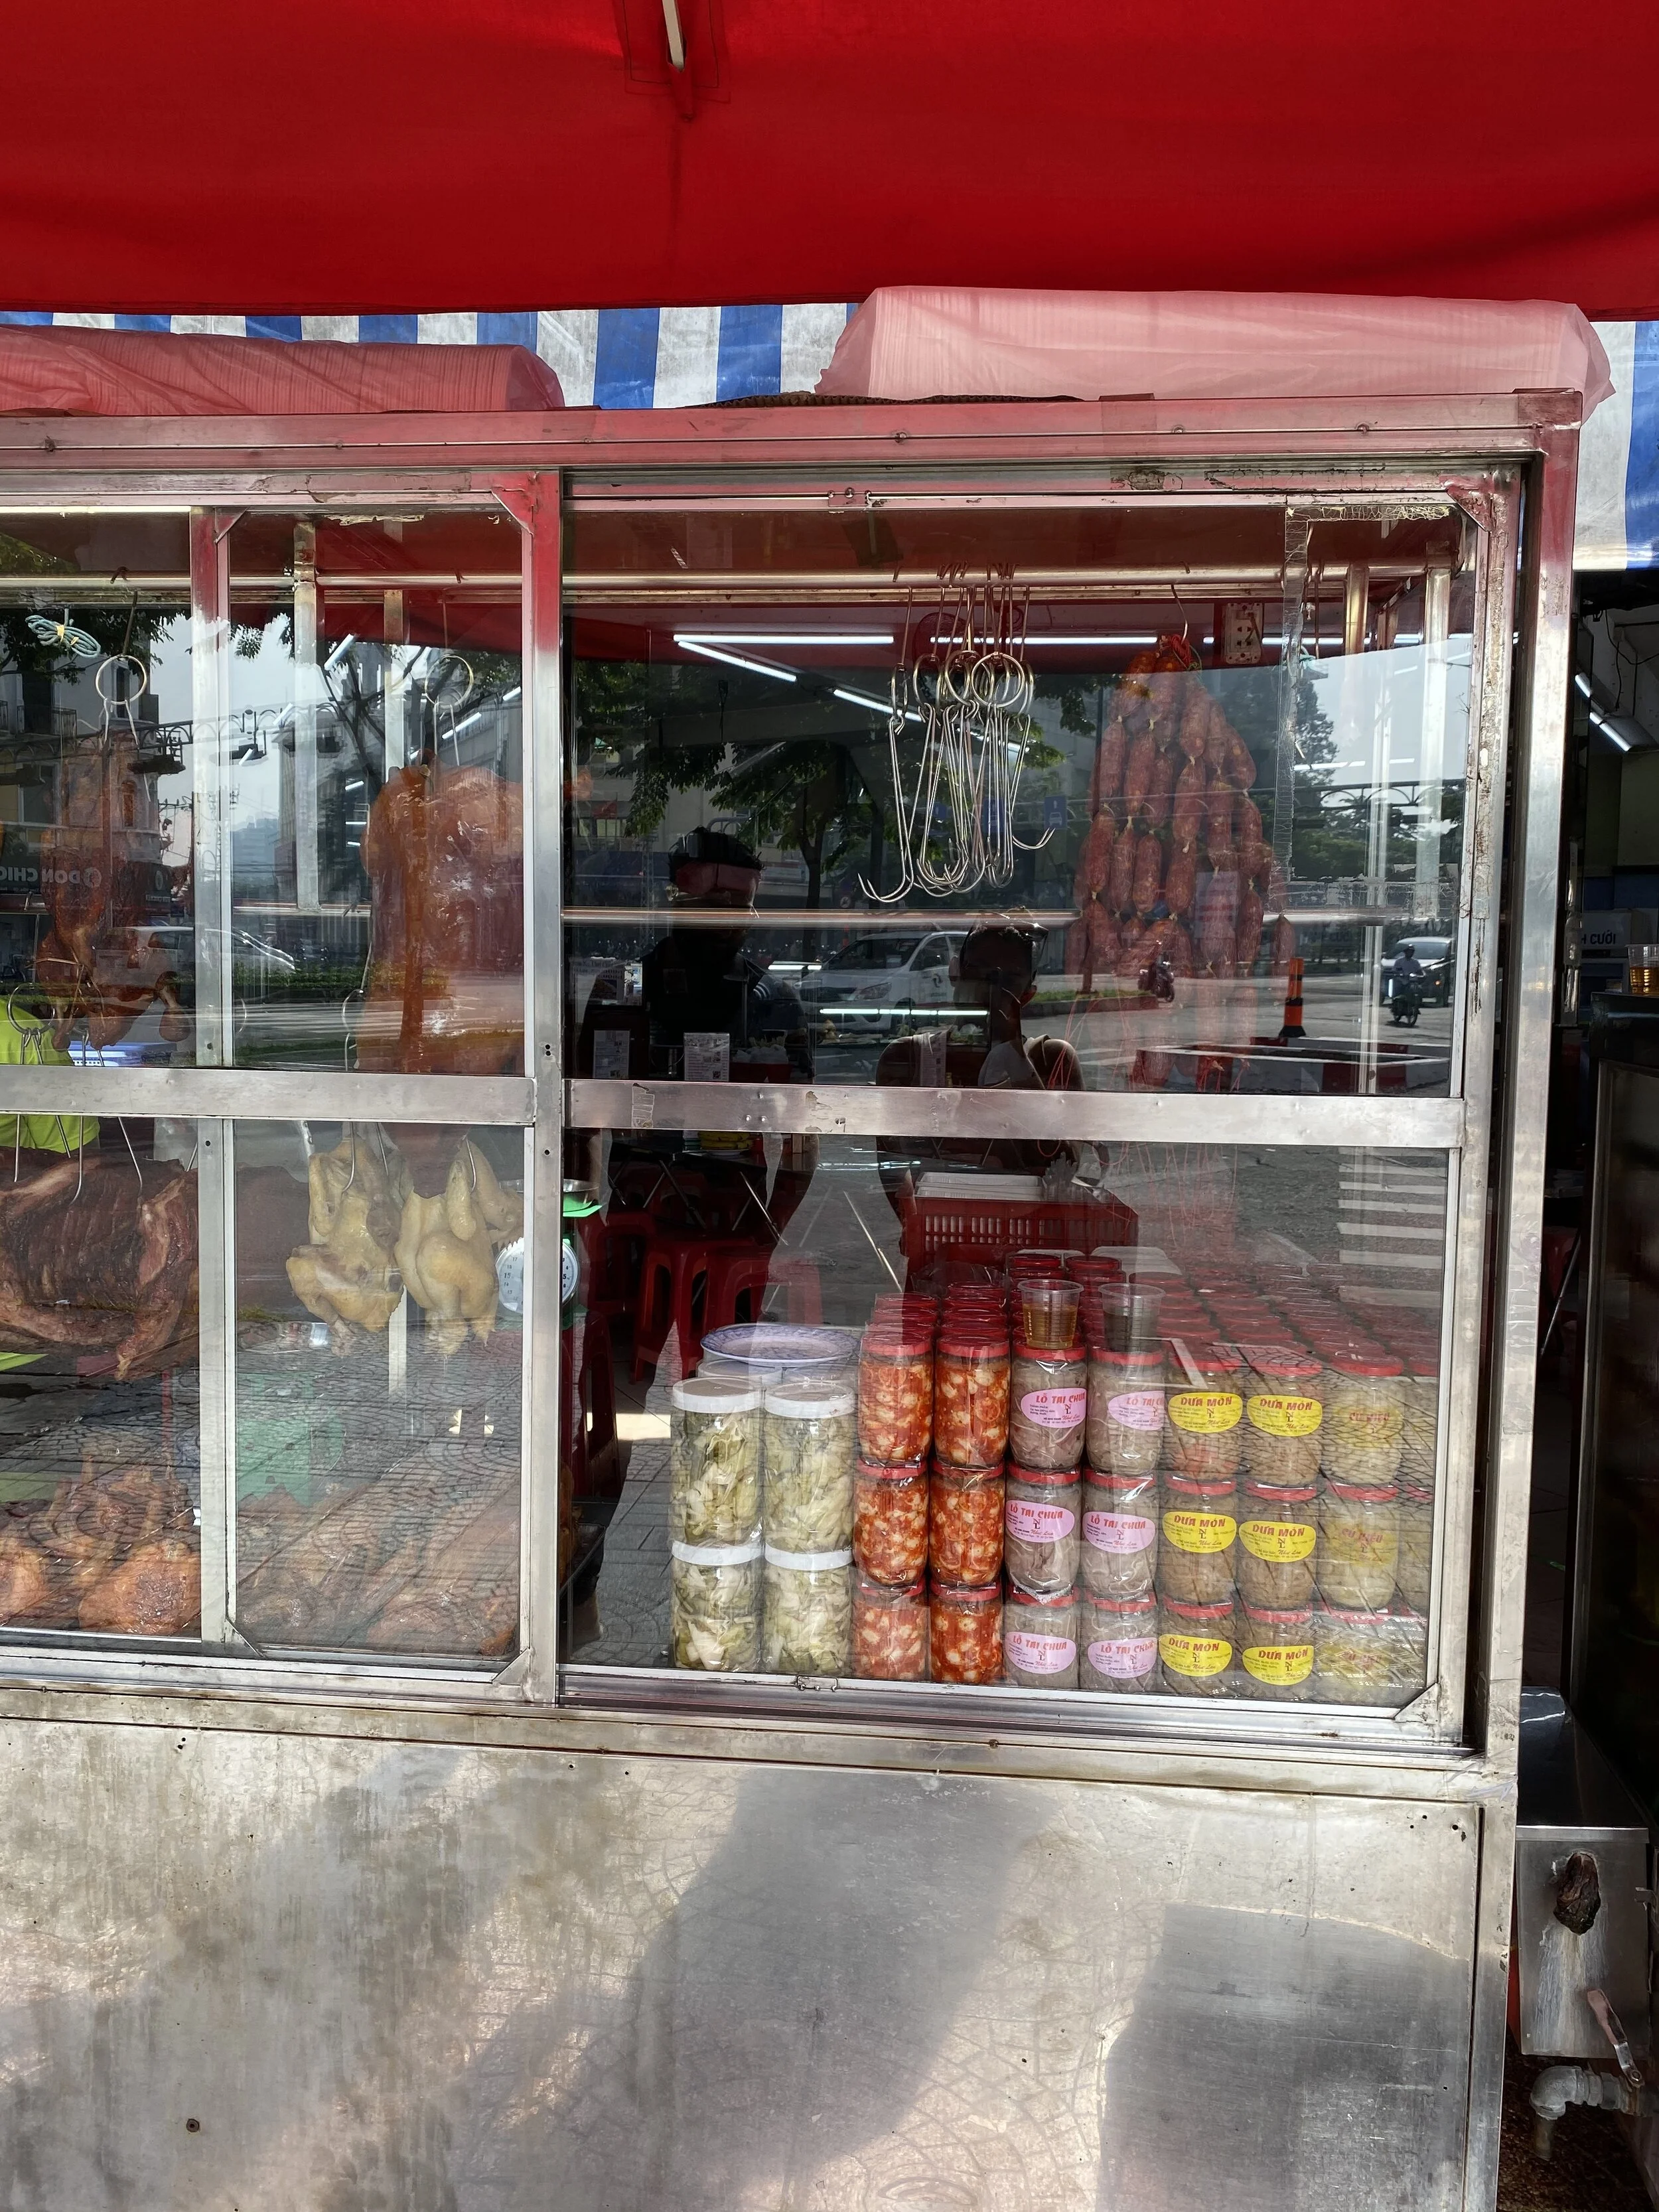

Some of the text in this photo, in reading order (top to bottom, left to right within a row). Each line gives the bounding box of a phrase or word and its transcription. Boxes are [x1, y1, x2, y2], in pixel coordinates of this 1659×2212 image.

[1590, 930, 1616, 944] CƯỚI
[1021, 1507, 1035, 1517] TAI
[1104, 1518, 1119, 1528] TAI
[1025, 1639, 1040, 1649] TAI
